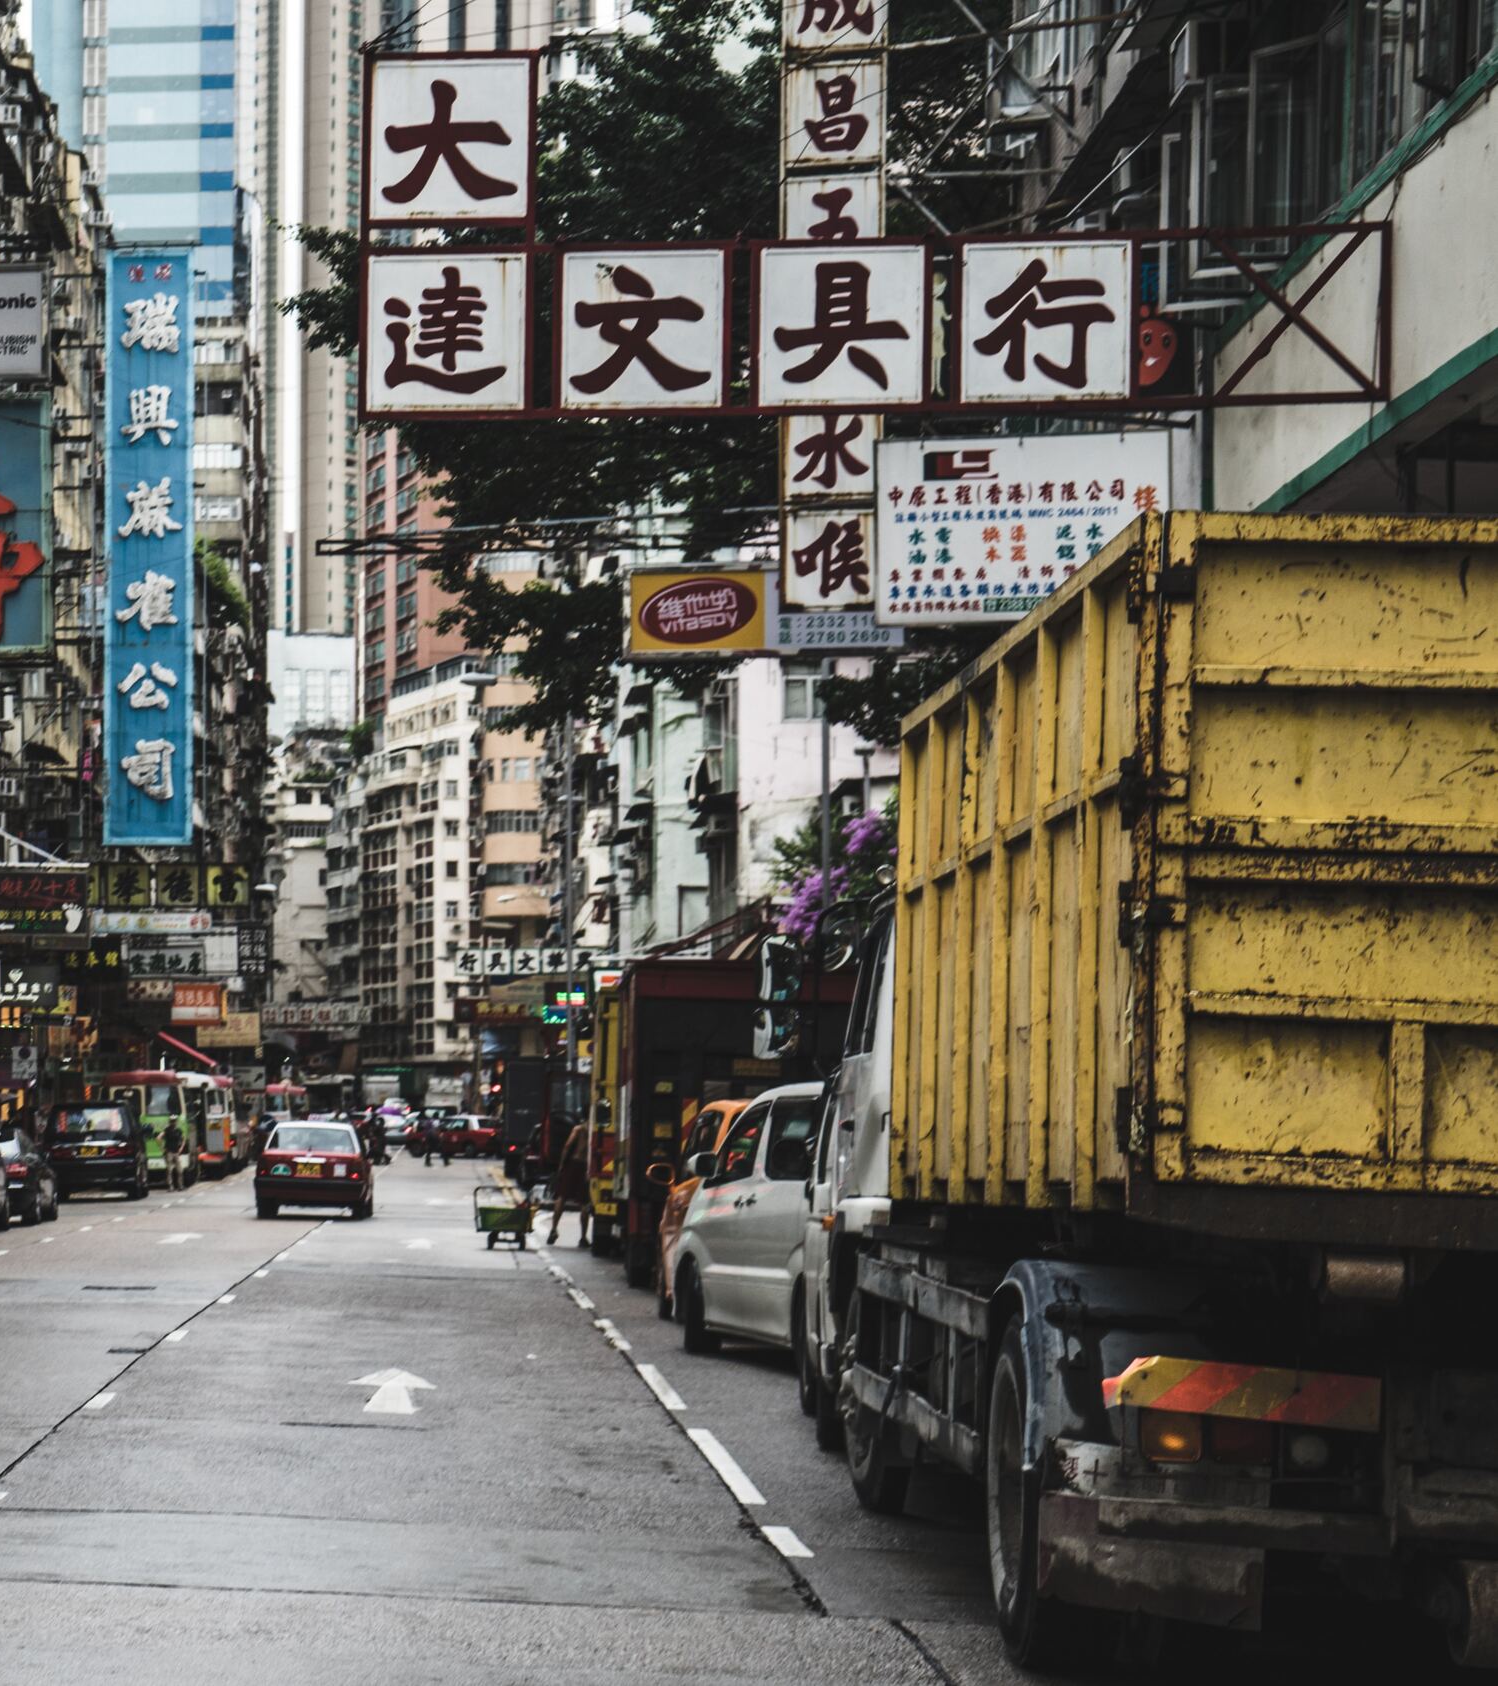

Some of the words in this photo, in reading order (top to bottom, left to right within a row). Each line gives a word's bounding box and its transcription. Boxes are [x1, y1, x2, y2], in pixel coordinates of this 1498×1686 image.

[382, 79, 518, 203] 大
[384, 257, 1115, 395] 達文具行
[659, 610, 738, 634] vitasoy
